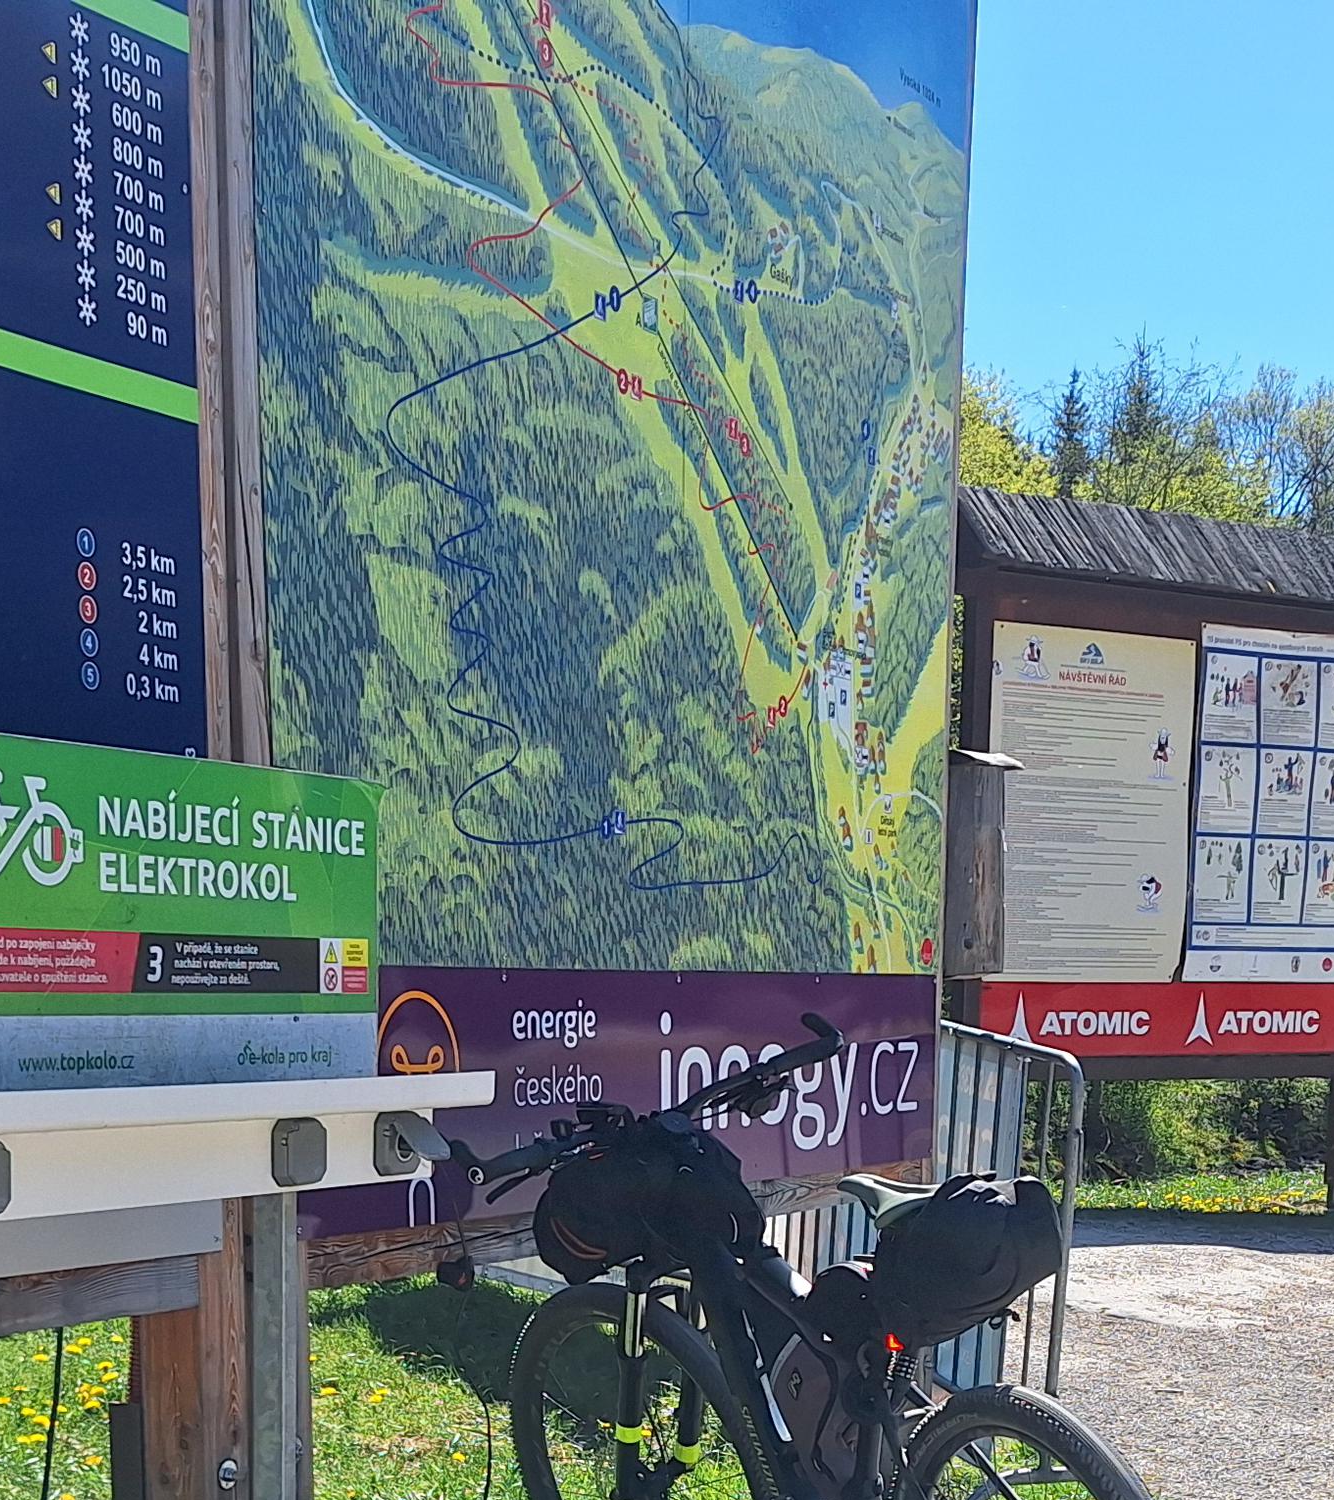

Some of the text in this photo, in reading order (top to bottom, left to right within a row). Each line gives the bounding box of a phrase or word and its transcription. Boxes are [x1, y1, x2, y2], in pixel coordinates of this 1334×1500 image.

[109, 32, 162, 77] 950 m
[101, 63, 162, 112] 1050 m
[111, 102, 163, 146] 600 m
[112, 137, 163, 179] 800 m
[113, 170, 164, 213] 700 m
[114, 205, 165, 247] 700 m
[115, 240, 166, 280] 500 m
[116, 274, 166, 314] 250 m
[127, 311, 167, 346] 90 m
[82, 535, 176, 575] 1 3,5 km
[83, 568, 177, 608] 2 2,5 km
[84, 602, 178, 639] 3 2 km
[85, 635, 179, 671] 4 4 km
[86, 668, 180, 703] 5 0,3 km
[98, 789, 366, 856] NABÍJECÍ STANICE
[99, 852, 297, 901] ELEKTROKOL
[6, 940, 17, 951] po
[10, 955, 16, 966] k
[147, 945, 163, 982] 3
[175, 942, 182, 953] V
[224, 945, 232, 954] se
[233, 943, 258, 955] stanice
[512, 999, 596, 1048] energie
[1039, 1011, 1150, 1036] ATOMIC
[1217, 1010, 1320, 1035] ATOMIC
[18, 1049, 135, 1075] www.topkolo.cz
[288, 1051, 307, 1069] pro
[311, 1044, 332, 1067] kraj
[514, 1064, 602, 1106] českého
